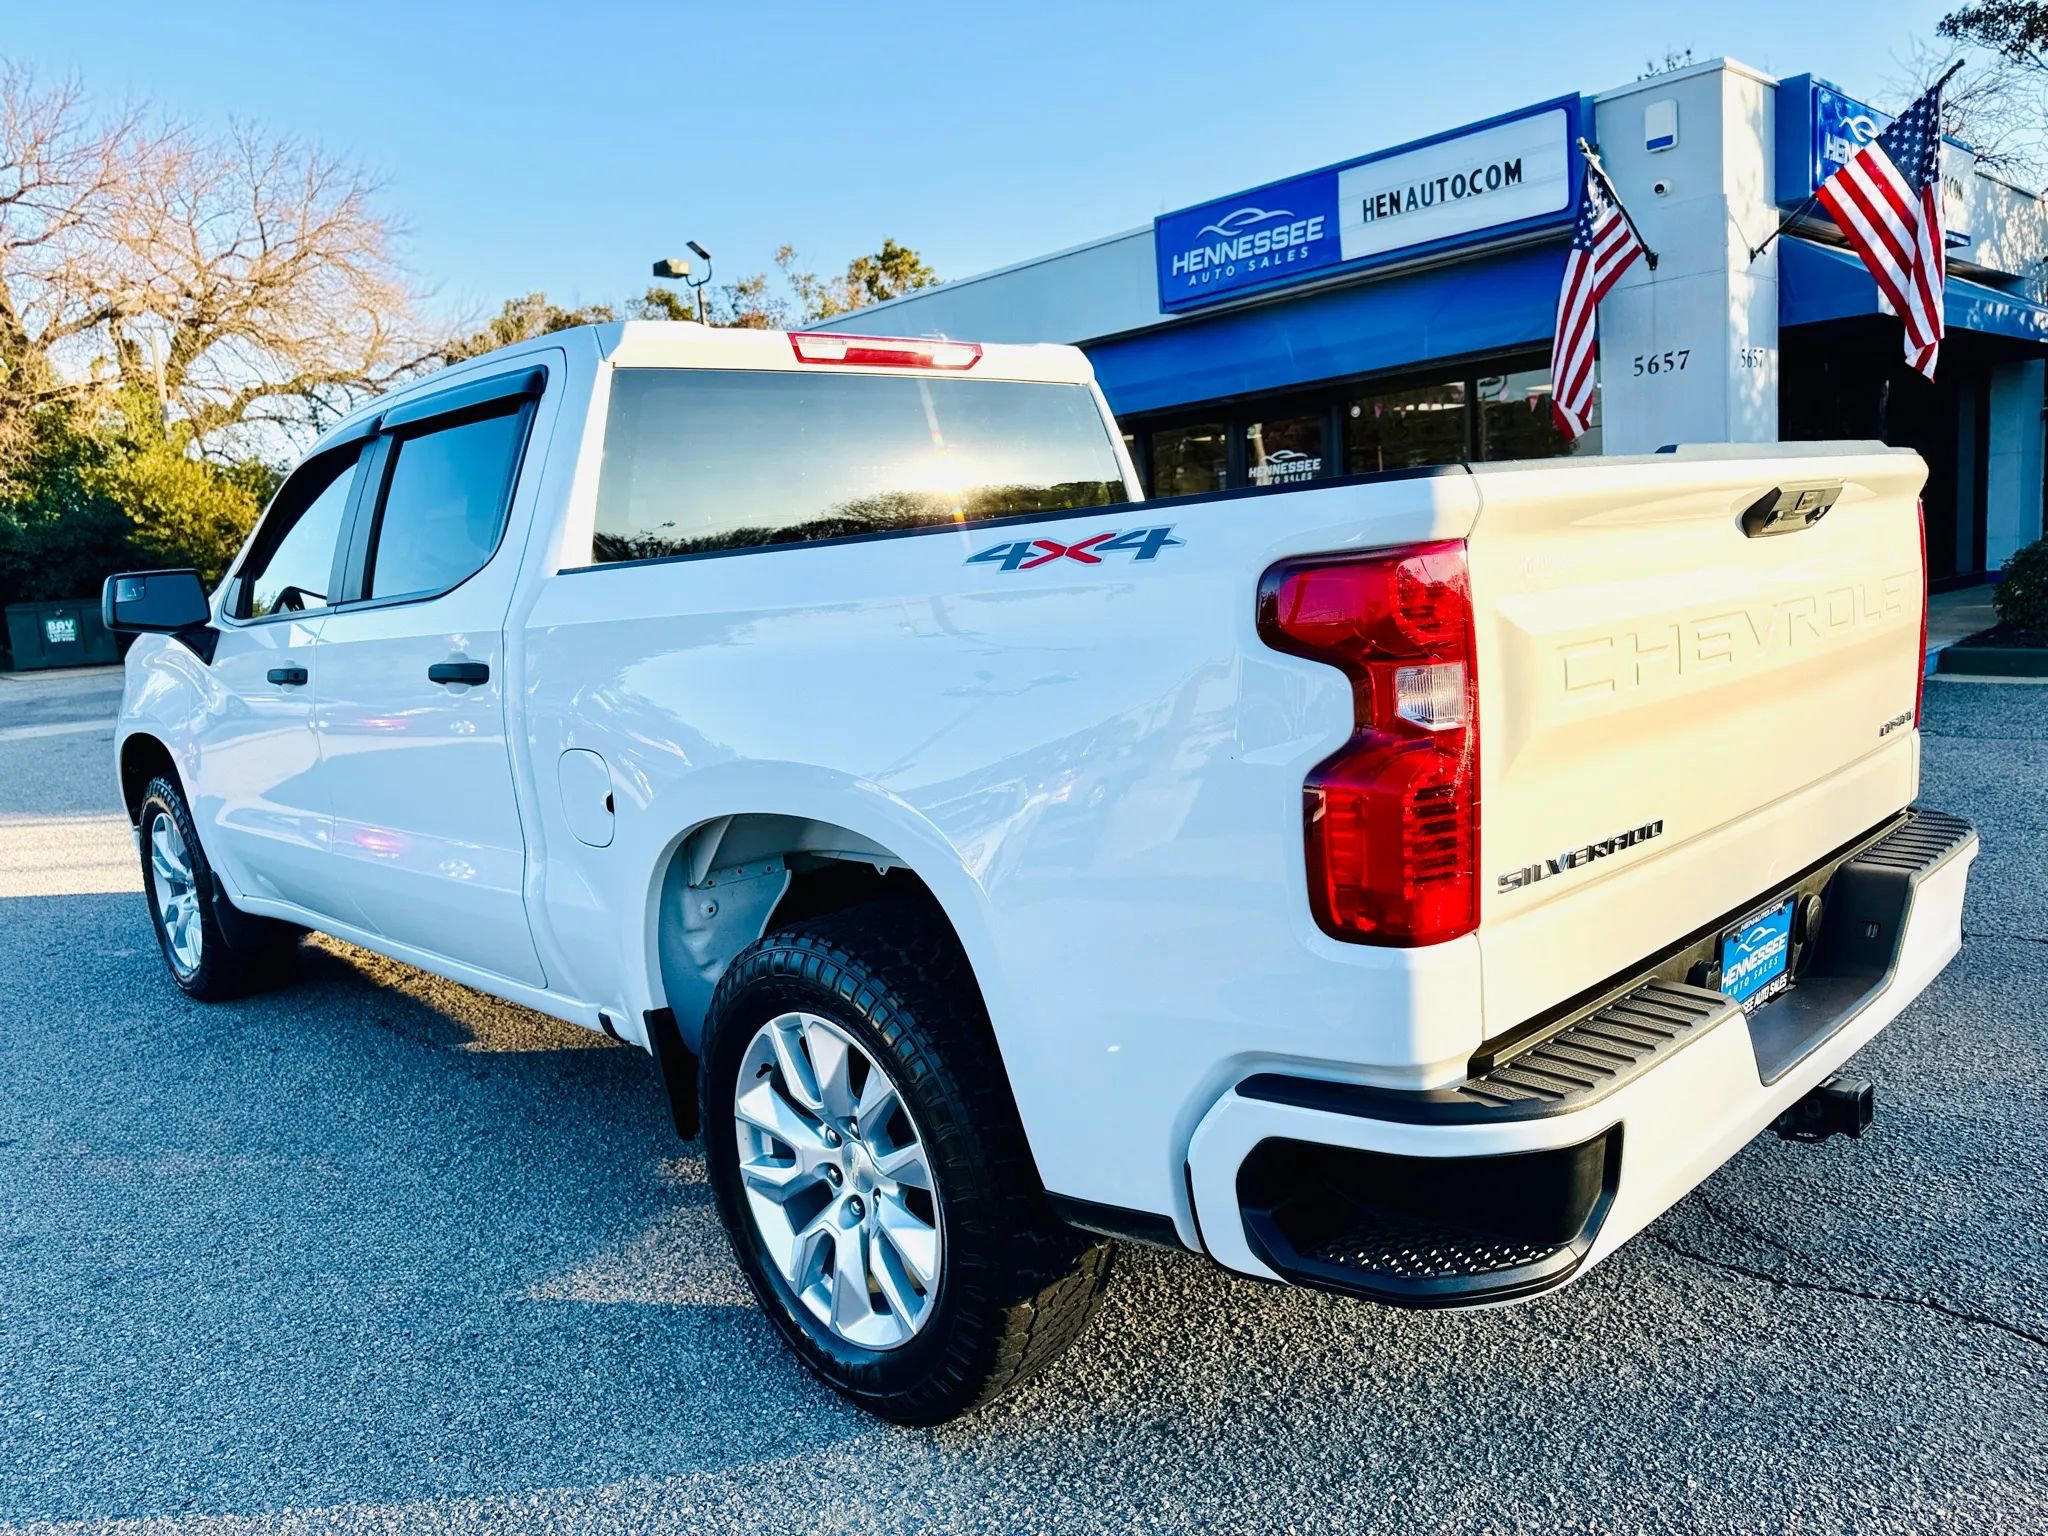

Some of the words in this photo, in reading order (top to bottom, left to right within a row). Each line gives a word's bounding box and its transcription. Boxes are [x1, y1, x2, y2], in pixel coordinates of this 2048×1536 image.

[1363, 158, 1522, 223] HENAUTO.COM
[1172, 215, 1325, 276] HENNESSEE
[1188, 264, 1236, 287] AUTO
[1248, 246, 1309, 272] SALES
[1633, 349, 1690, 377] 5657
[1741, 348, 1764, 369] 5657
[1248, 458, 1322, 478] HENNESSEE
[1283, 472, 1313, 483] SALES
[47, 619, 74, 631] BAY
[1556, 569, 1919, 703] CHEVROLET
[1497, 819, 1664, 895] SILVERADO
[1721, 931, 1788, 988] HENNESSEE
[1728, 976, 1750, 996] AUTO
[1753, 955, 1779, 980] SALES
[1768, 973, 1788, 998] SALES
